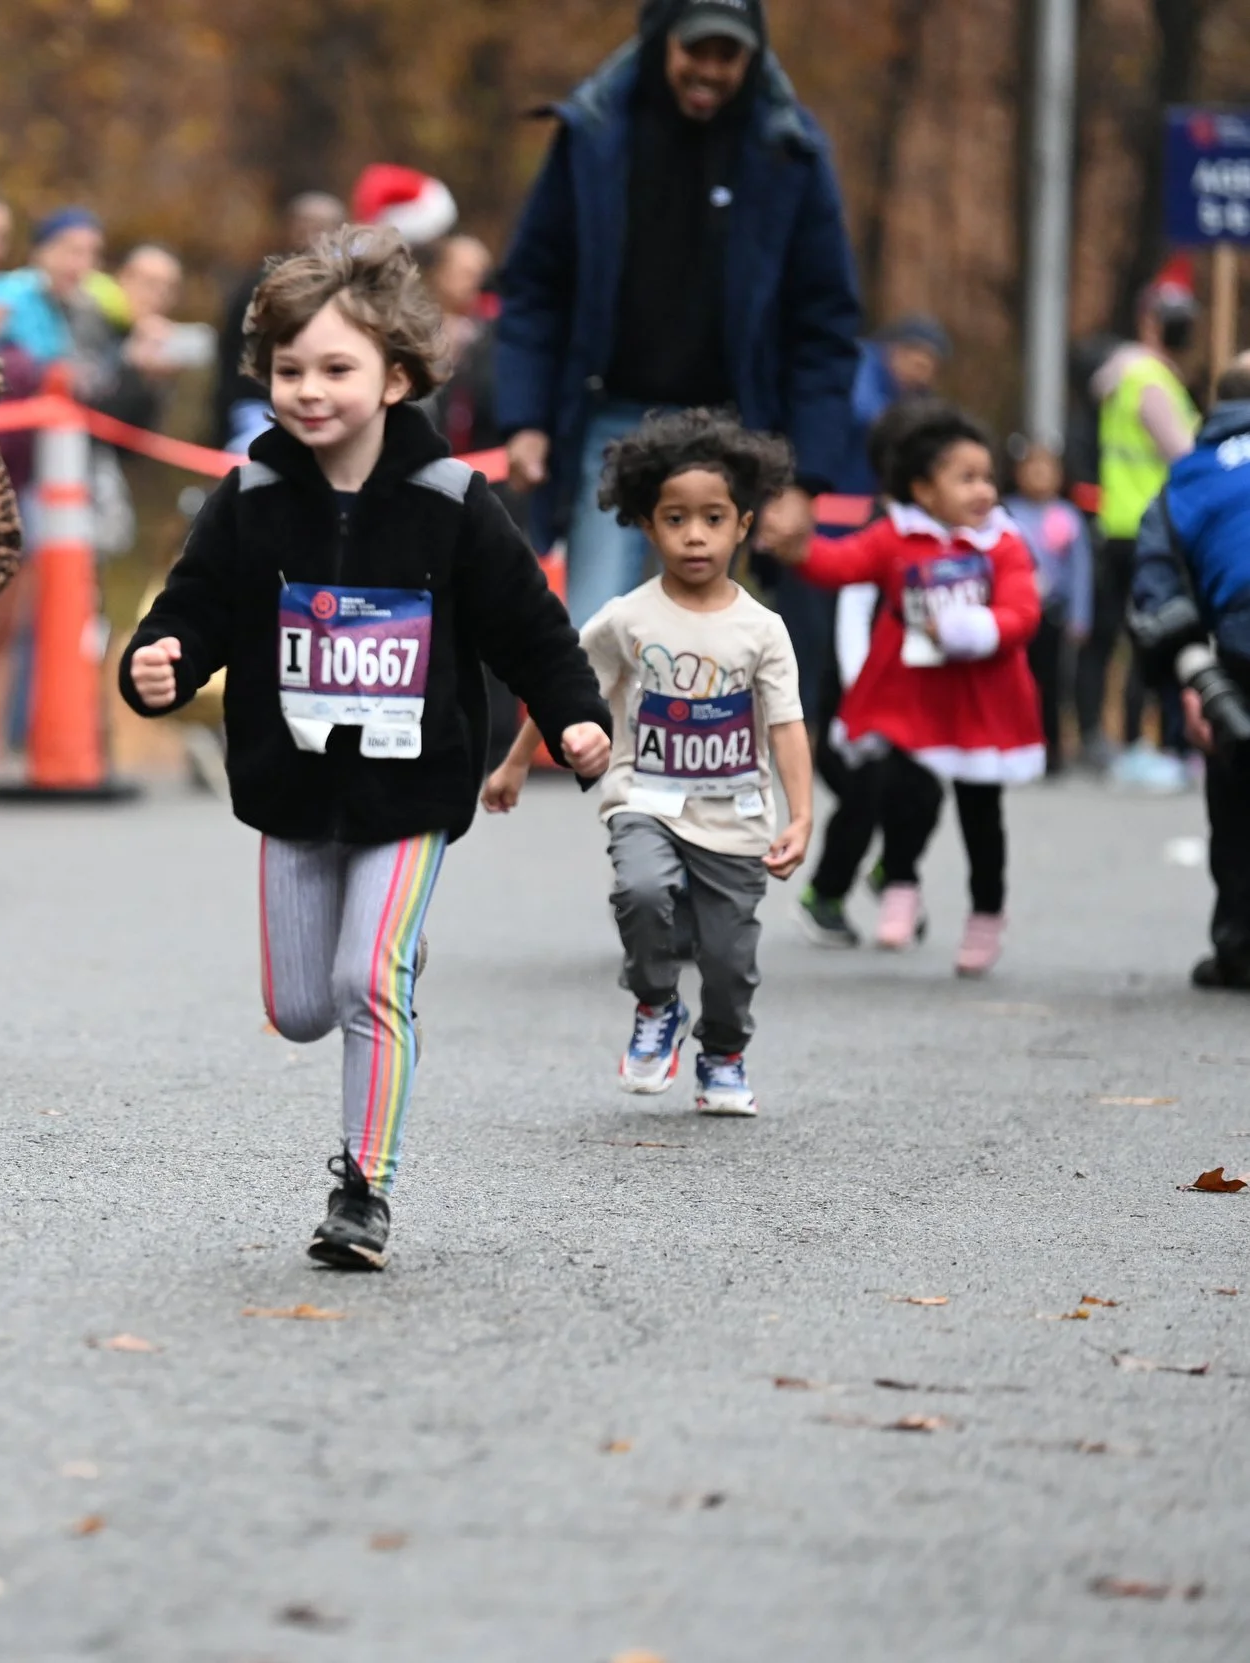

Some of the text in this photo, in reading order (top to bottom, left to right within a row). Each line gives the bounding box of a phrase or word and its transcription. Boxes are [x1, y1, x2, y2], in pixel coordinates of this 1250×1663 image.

[287, 632, 419, 687] I 10667
[641, 727, 751, 771] A 10042
